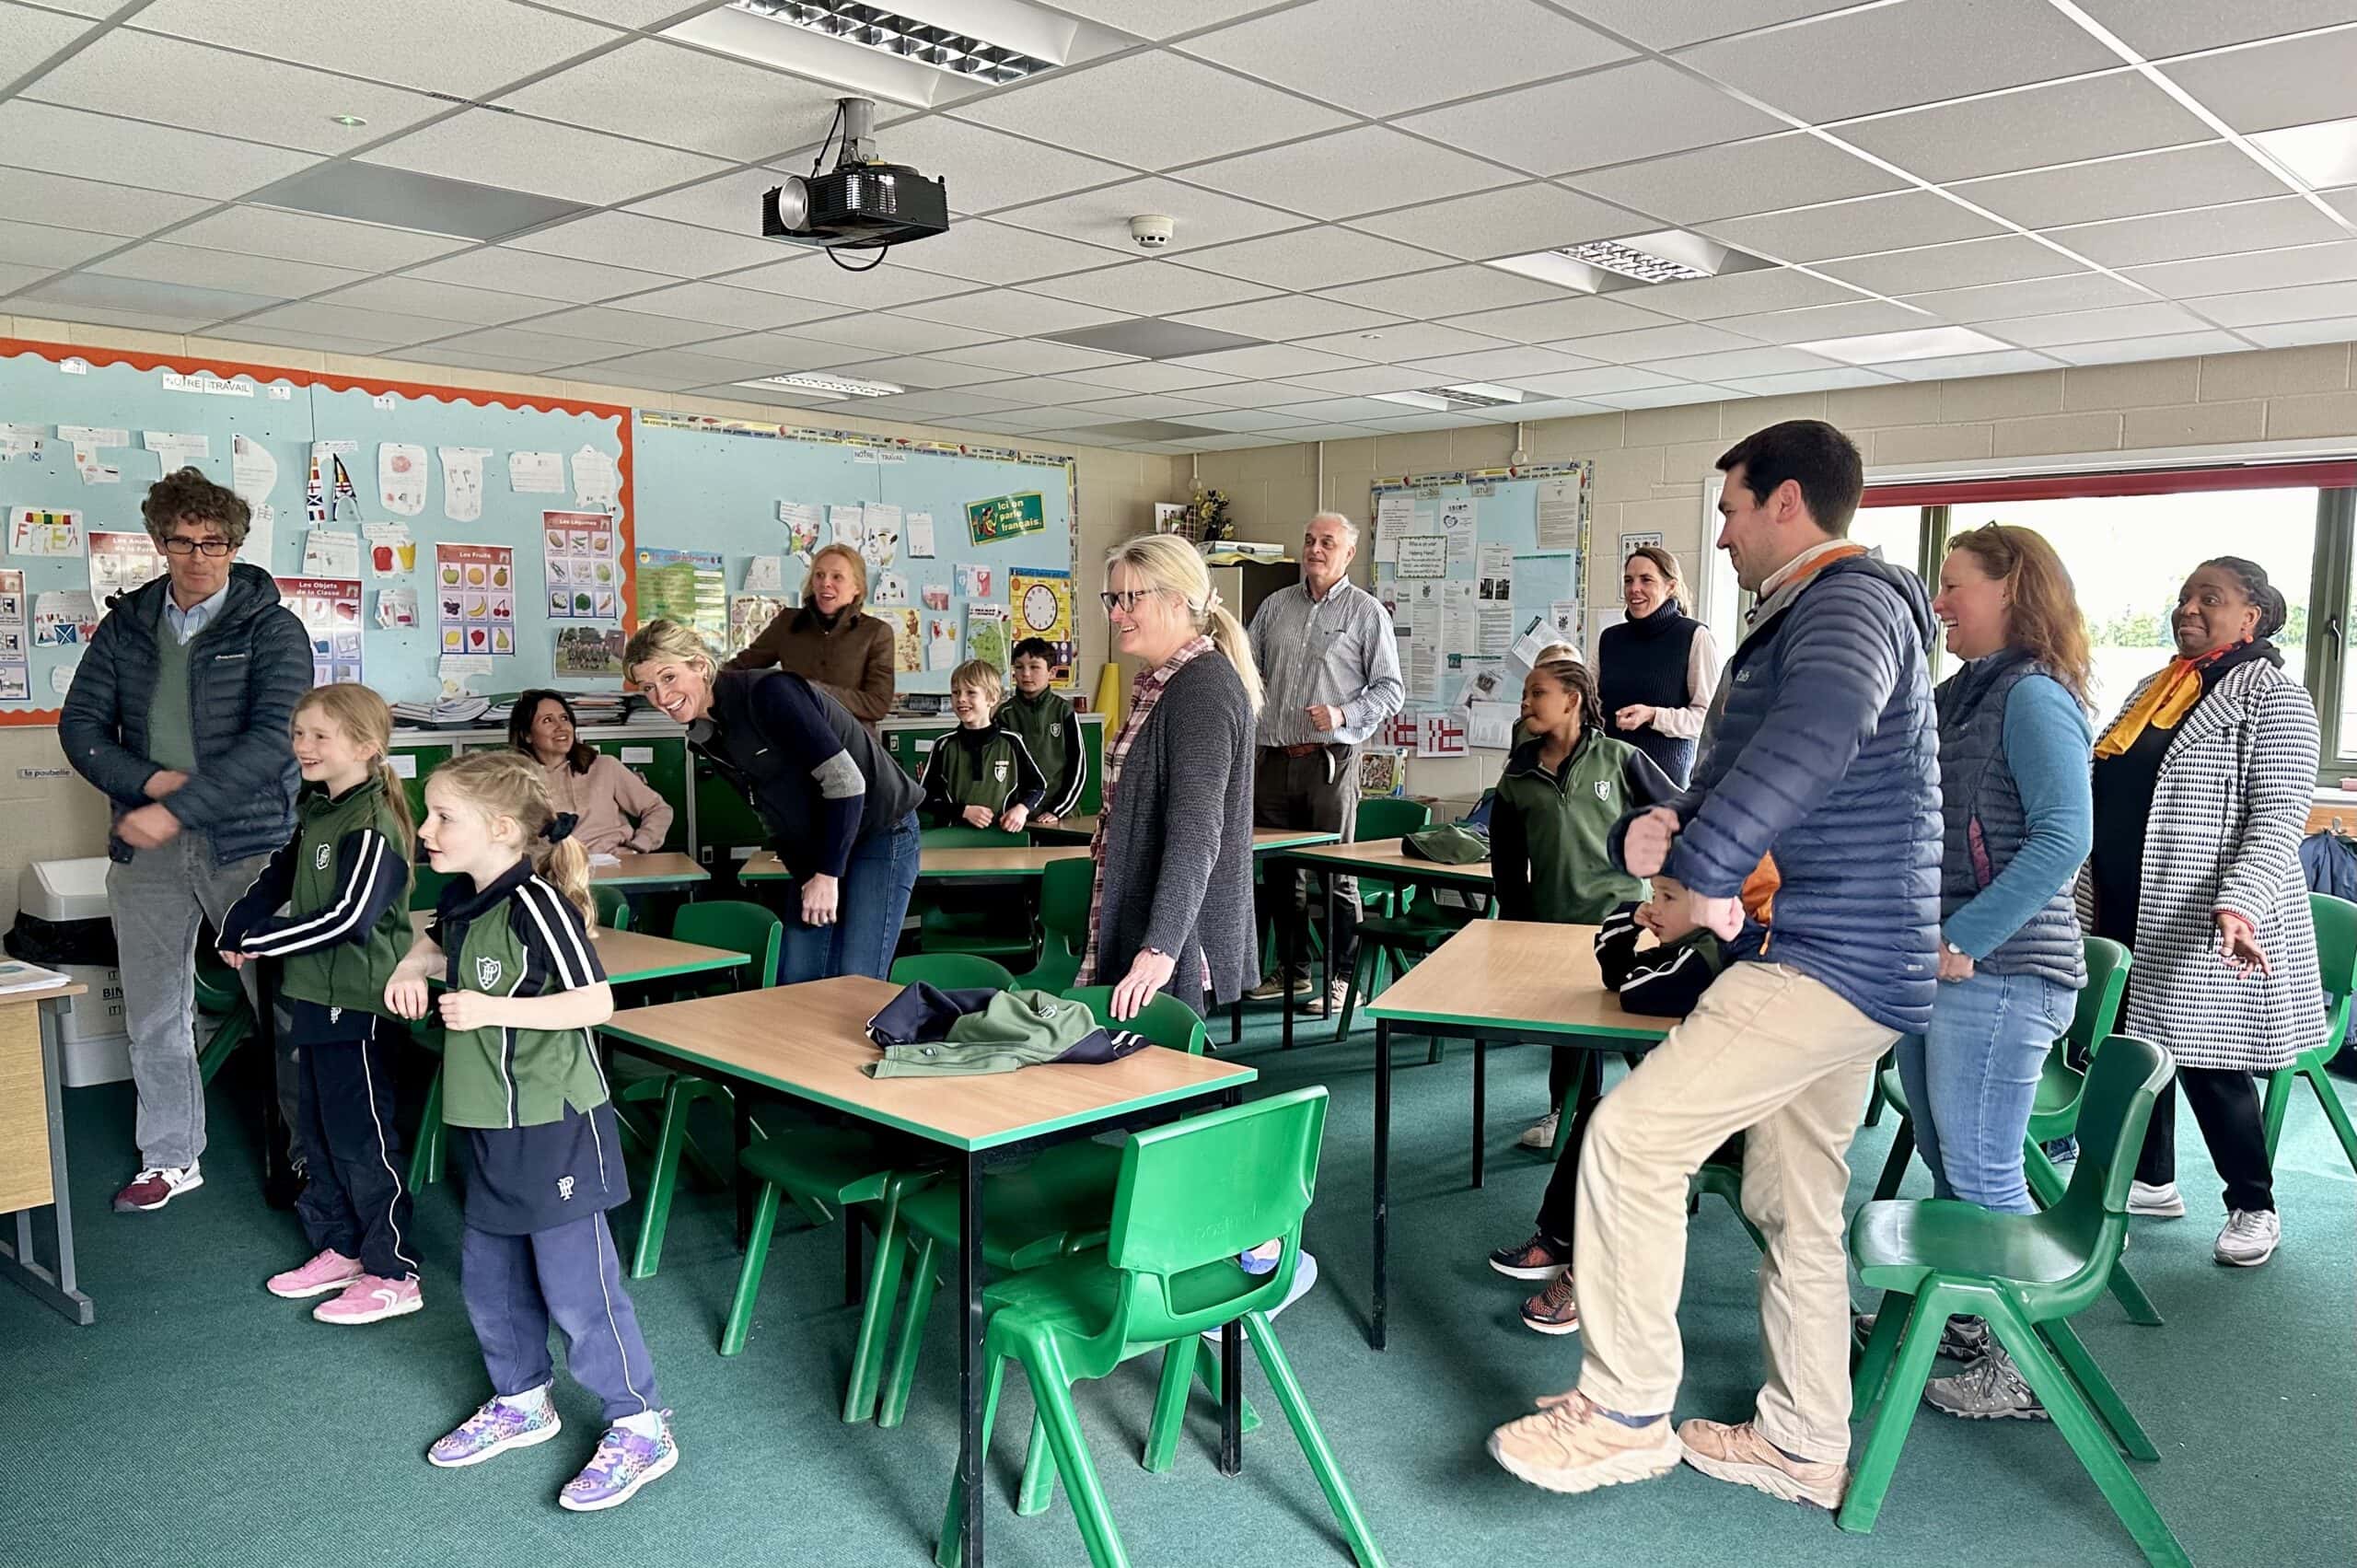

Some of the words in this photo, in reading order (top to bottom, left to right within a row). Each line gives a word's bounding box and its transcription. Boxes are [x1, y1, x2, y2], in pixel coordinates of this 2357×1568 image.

[210, 380, 250, 393] TRAVAIL
[853, 449, 874, 459] NOTRE
[997, 500, 1009, 511] Ici
[1011, 500, 1024, 508] on
[999, 509, 1023, 522] parle
[1001, 517, 1042, 532] français.
[313, 582, 338, 590] Objets
[34, 769, 71, 778] poubelle
[103, 987, 123, 998] BIN
